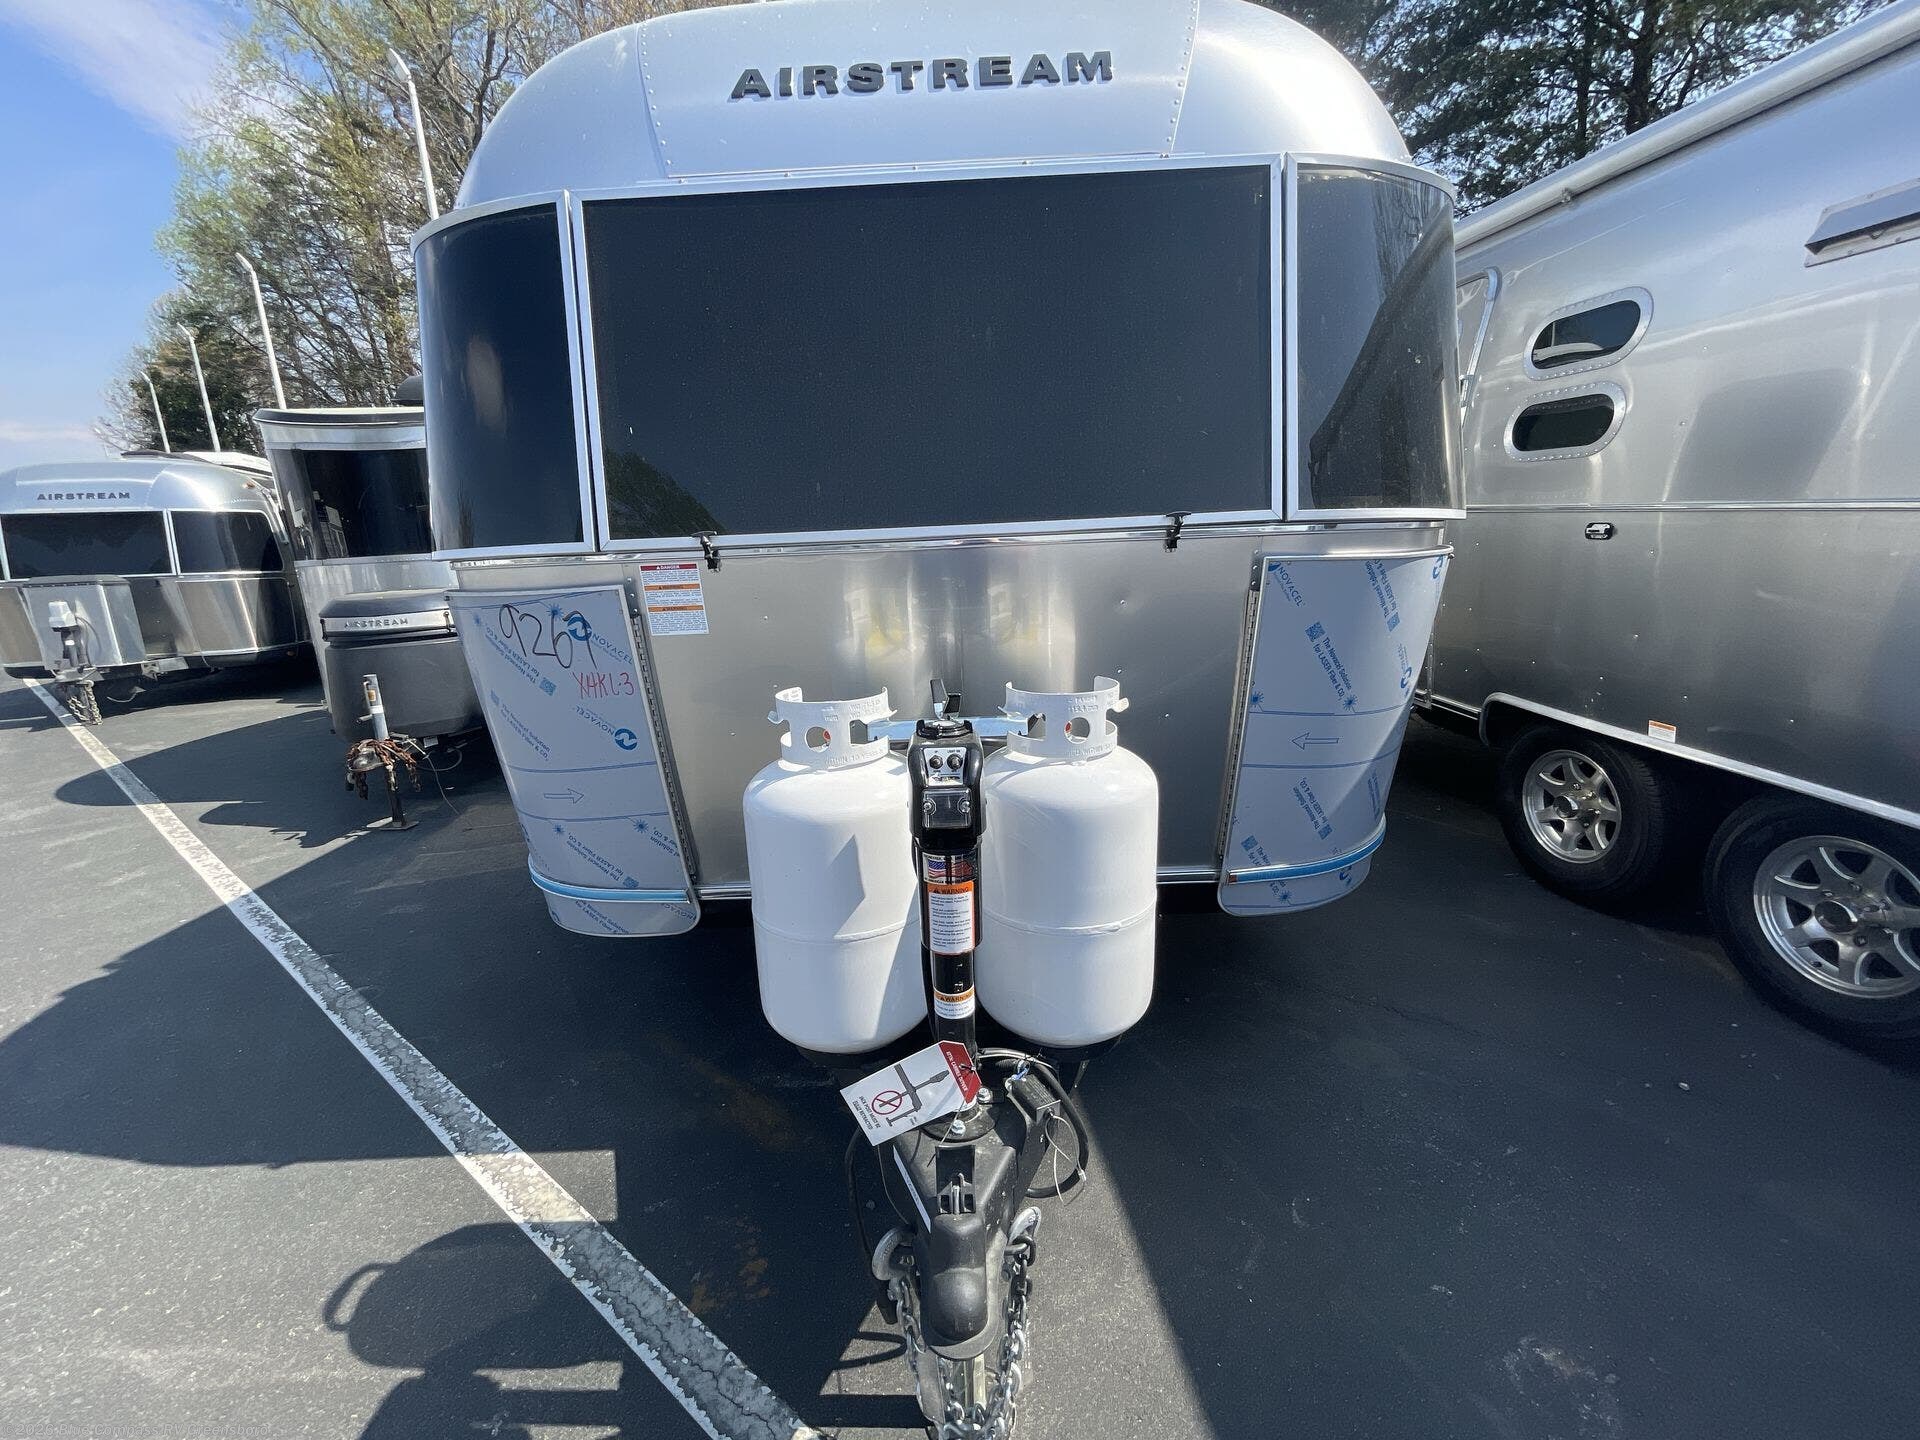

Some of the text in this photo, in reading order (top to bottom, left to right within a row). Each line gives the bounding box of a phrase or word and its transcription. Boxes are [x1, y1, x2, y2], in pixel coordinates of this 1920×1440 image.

[731, 51, 1113, 99] AIRSTREAM
[37, 492, 130, 500] AIRSTREAM
[1276, 567, 1305, 606] NOVACEL
[499, 603, 598, 670] 9269
[592, 633, 633, 665] NOVACEL
[575, 705, 615, 736] NOVACEL
